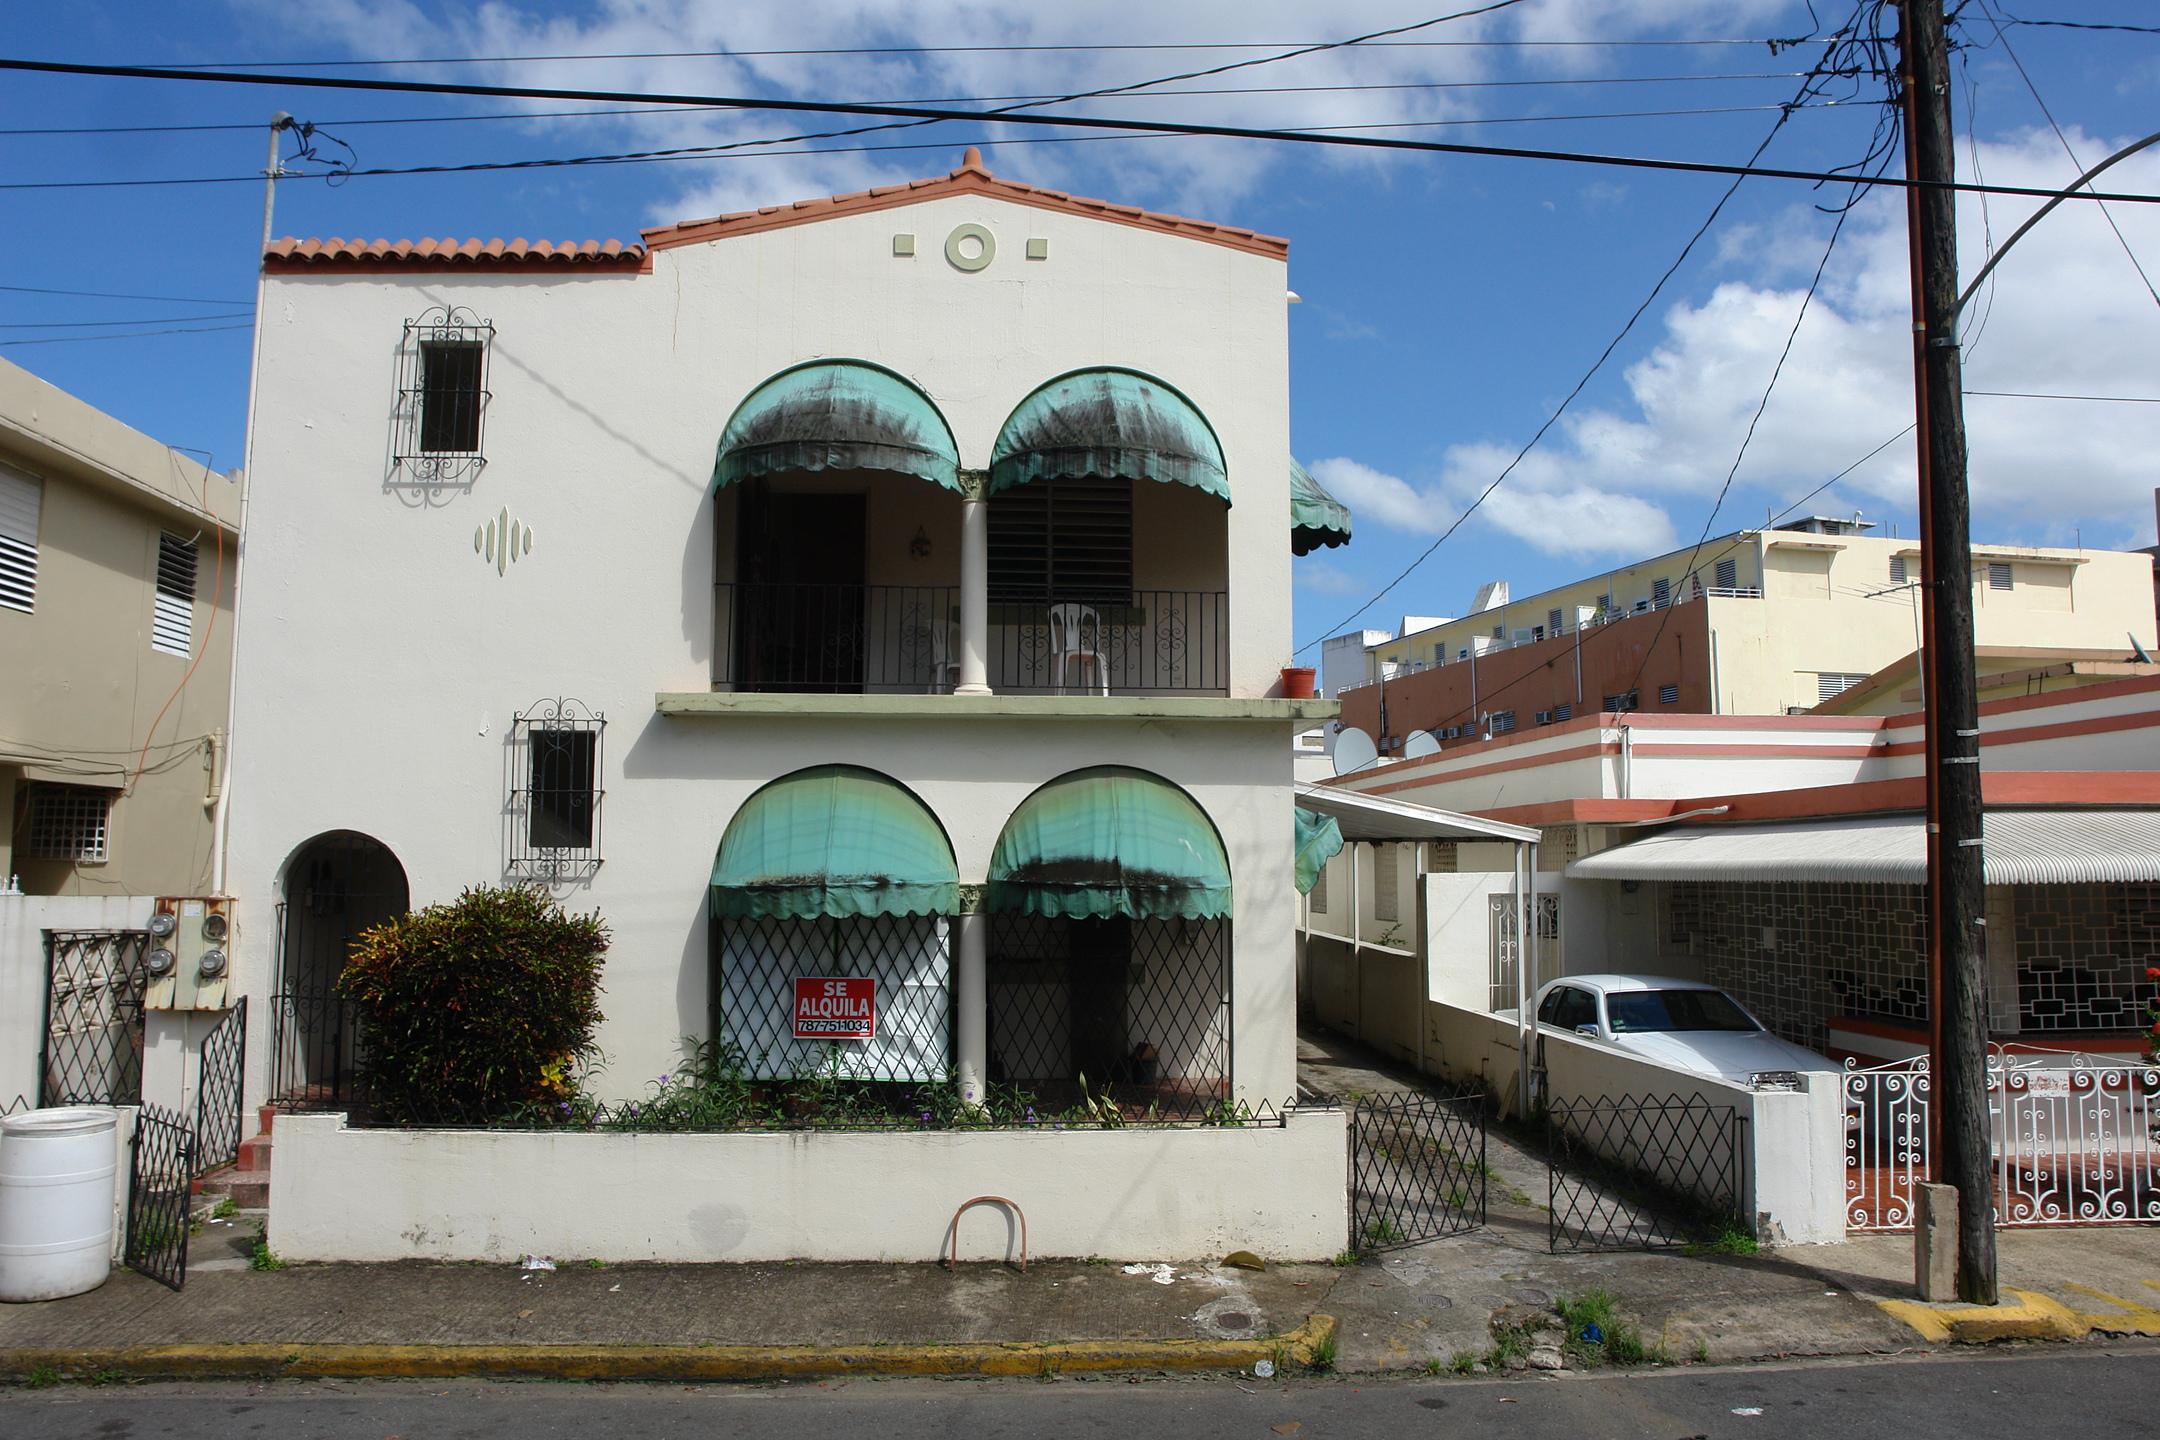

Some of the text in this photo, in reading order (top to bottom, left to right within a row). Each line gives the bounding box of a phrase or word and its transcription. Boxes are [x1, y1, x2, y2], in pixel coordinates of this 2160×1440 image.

[823, 981, 847, 997] SE
[799, 997, 870, 1018] ALQUILA
[799, 1020, 870, 1031] 787-751-1034
